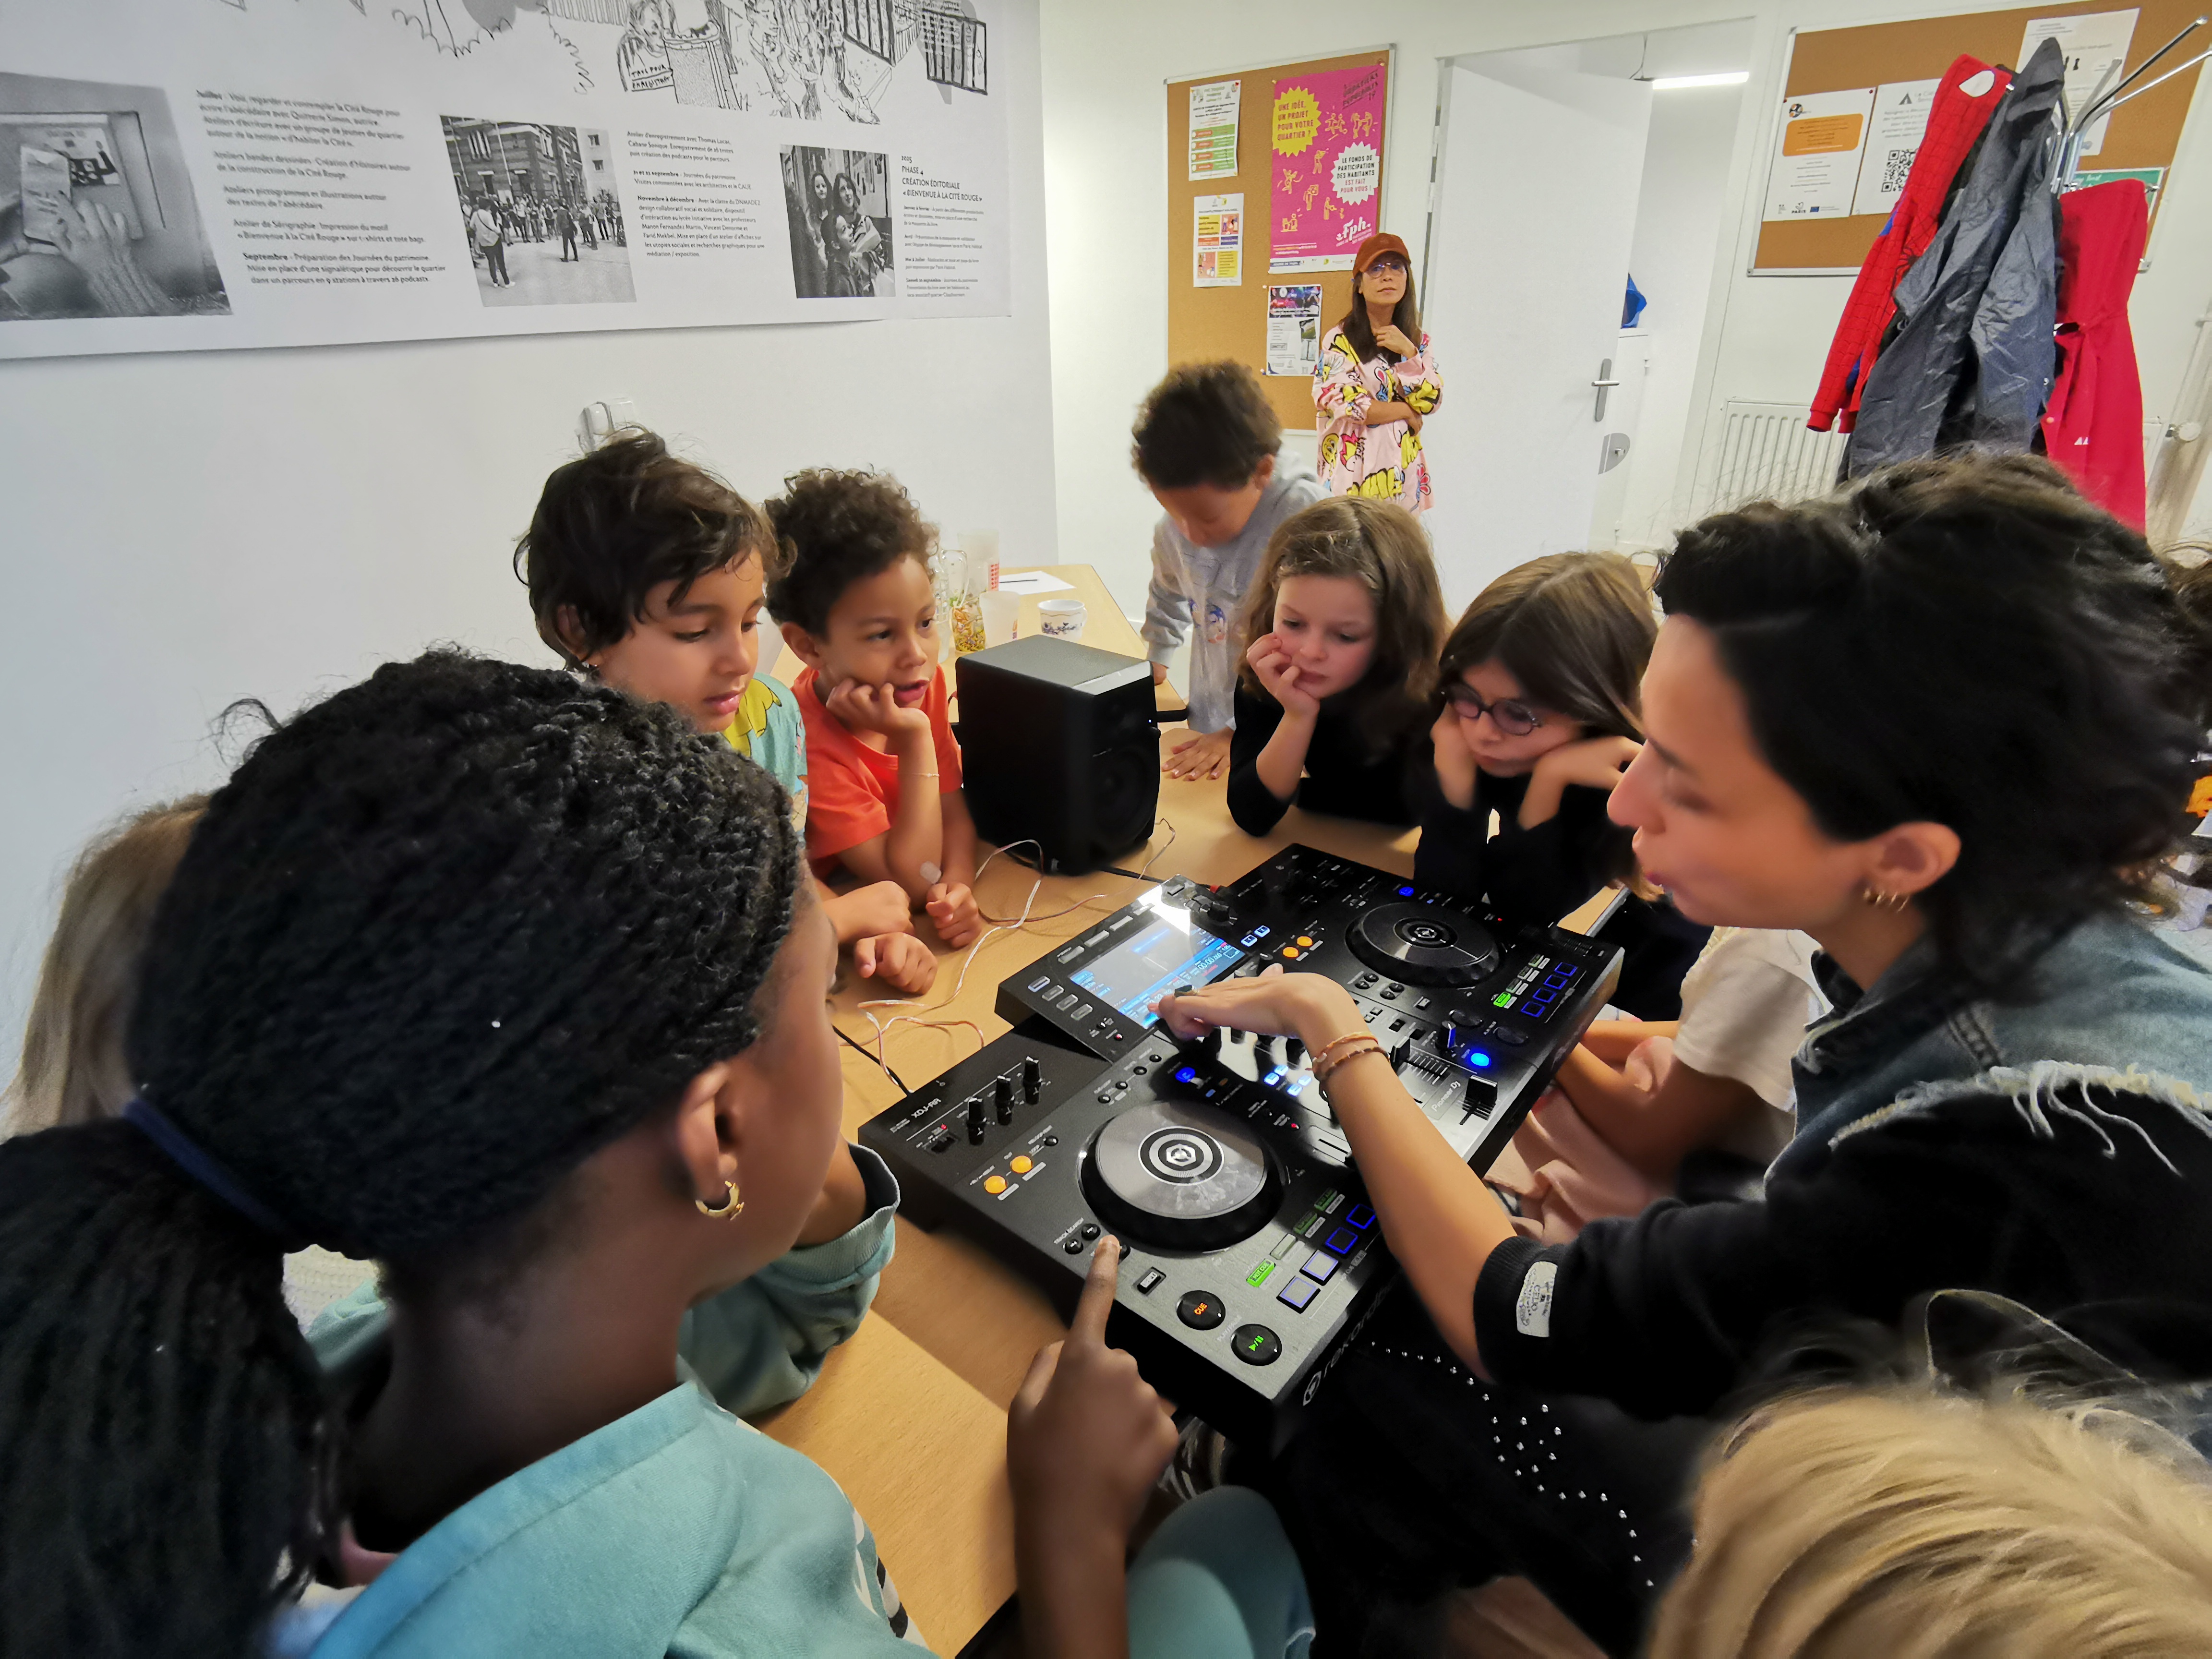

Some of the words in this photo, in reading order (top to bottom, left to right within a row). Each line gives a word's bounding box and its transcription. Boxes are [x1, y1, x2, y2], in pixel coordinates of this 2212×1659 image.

[1278, 102, 1289, 111] UNE
[1288, 110, 1309, 119] PROJET
[1277, 122, 1293, 131] POUR
[1295, 120, 1313, 128] VOTRE
[1277, 131, 1306, 141] QUARTIER
[902, 166, 919, 174] PHASE
[1338, 162, 1375, 171] PARTICIPATION
[902, 177, 929, 186] CRÉATION
[930, 178, 960, 189] ÉDITORIALE
[907, 189, 937, 198] BIENVENUE
[949, 191, 960, 200] CITÉ
[961, 193, 979, 202] ROUGE
[1431, 1088, 1453, 1112] Pioneer
[1193, 1302, 1208, 1315] CUE
